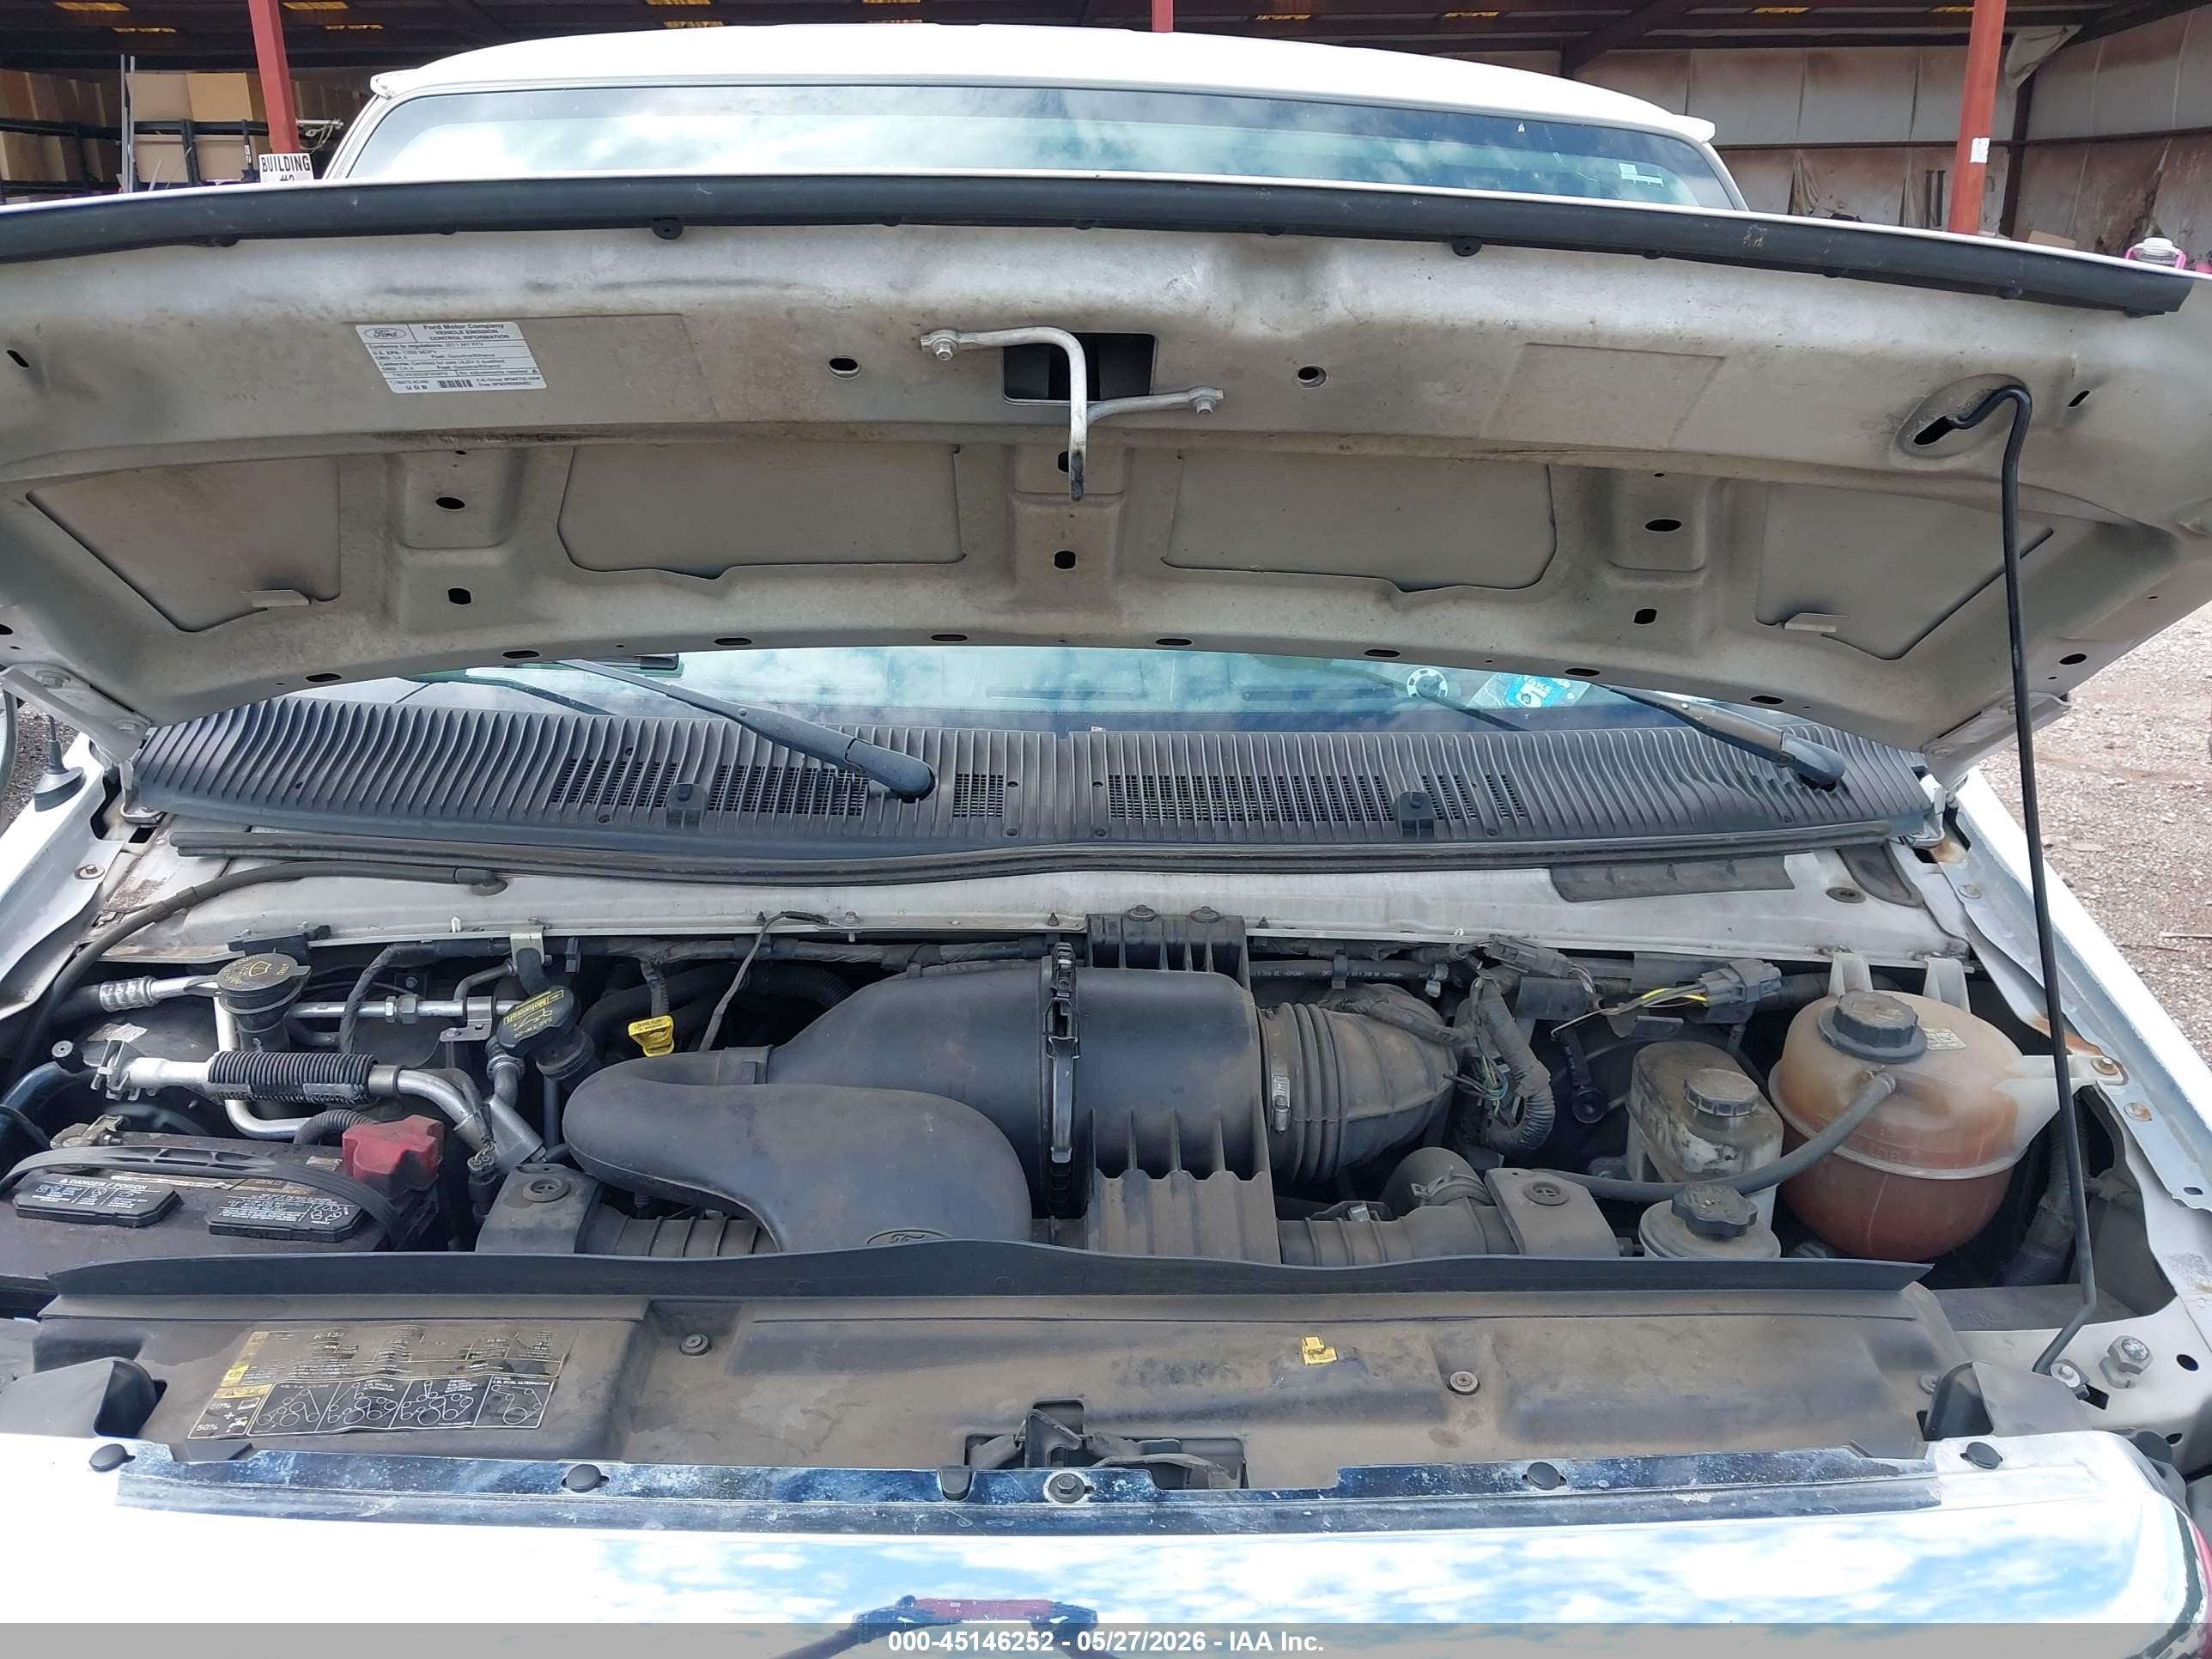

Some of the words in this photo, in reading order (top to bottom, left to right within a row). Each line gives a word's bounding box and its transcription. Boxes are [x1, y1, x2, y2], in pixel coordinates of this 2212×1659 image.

[260, 155, 311, 173] BUILDING
[506, 998, 548, 1024] Motorcraft
[68, 1179, 106, 1188] DANGER
[113, 1182, 148, 1191] POISON
[196, 1423, 220, 1431] 50%
